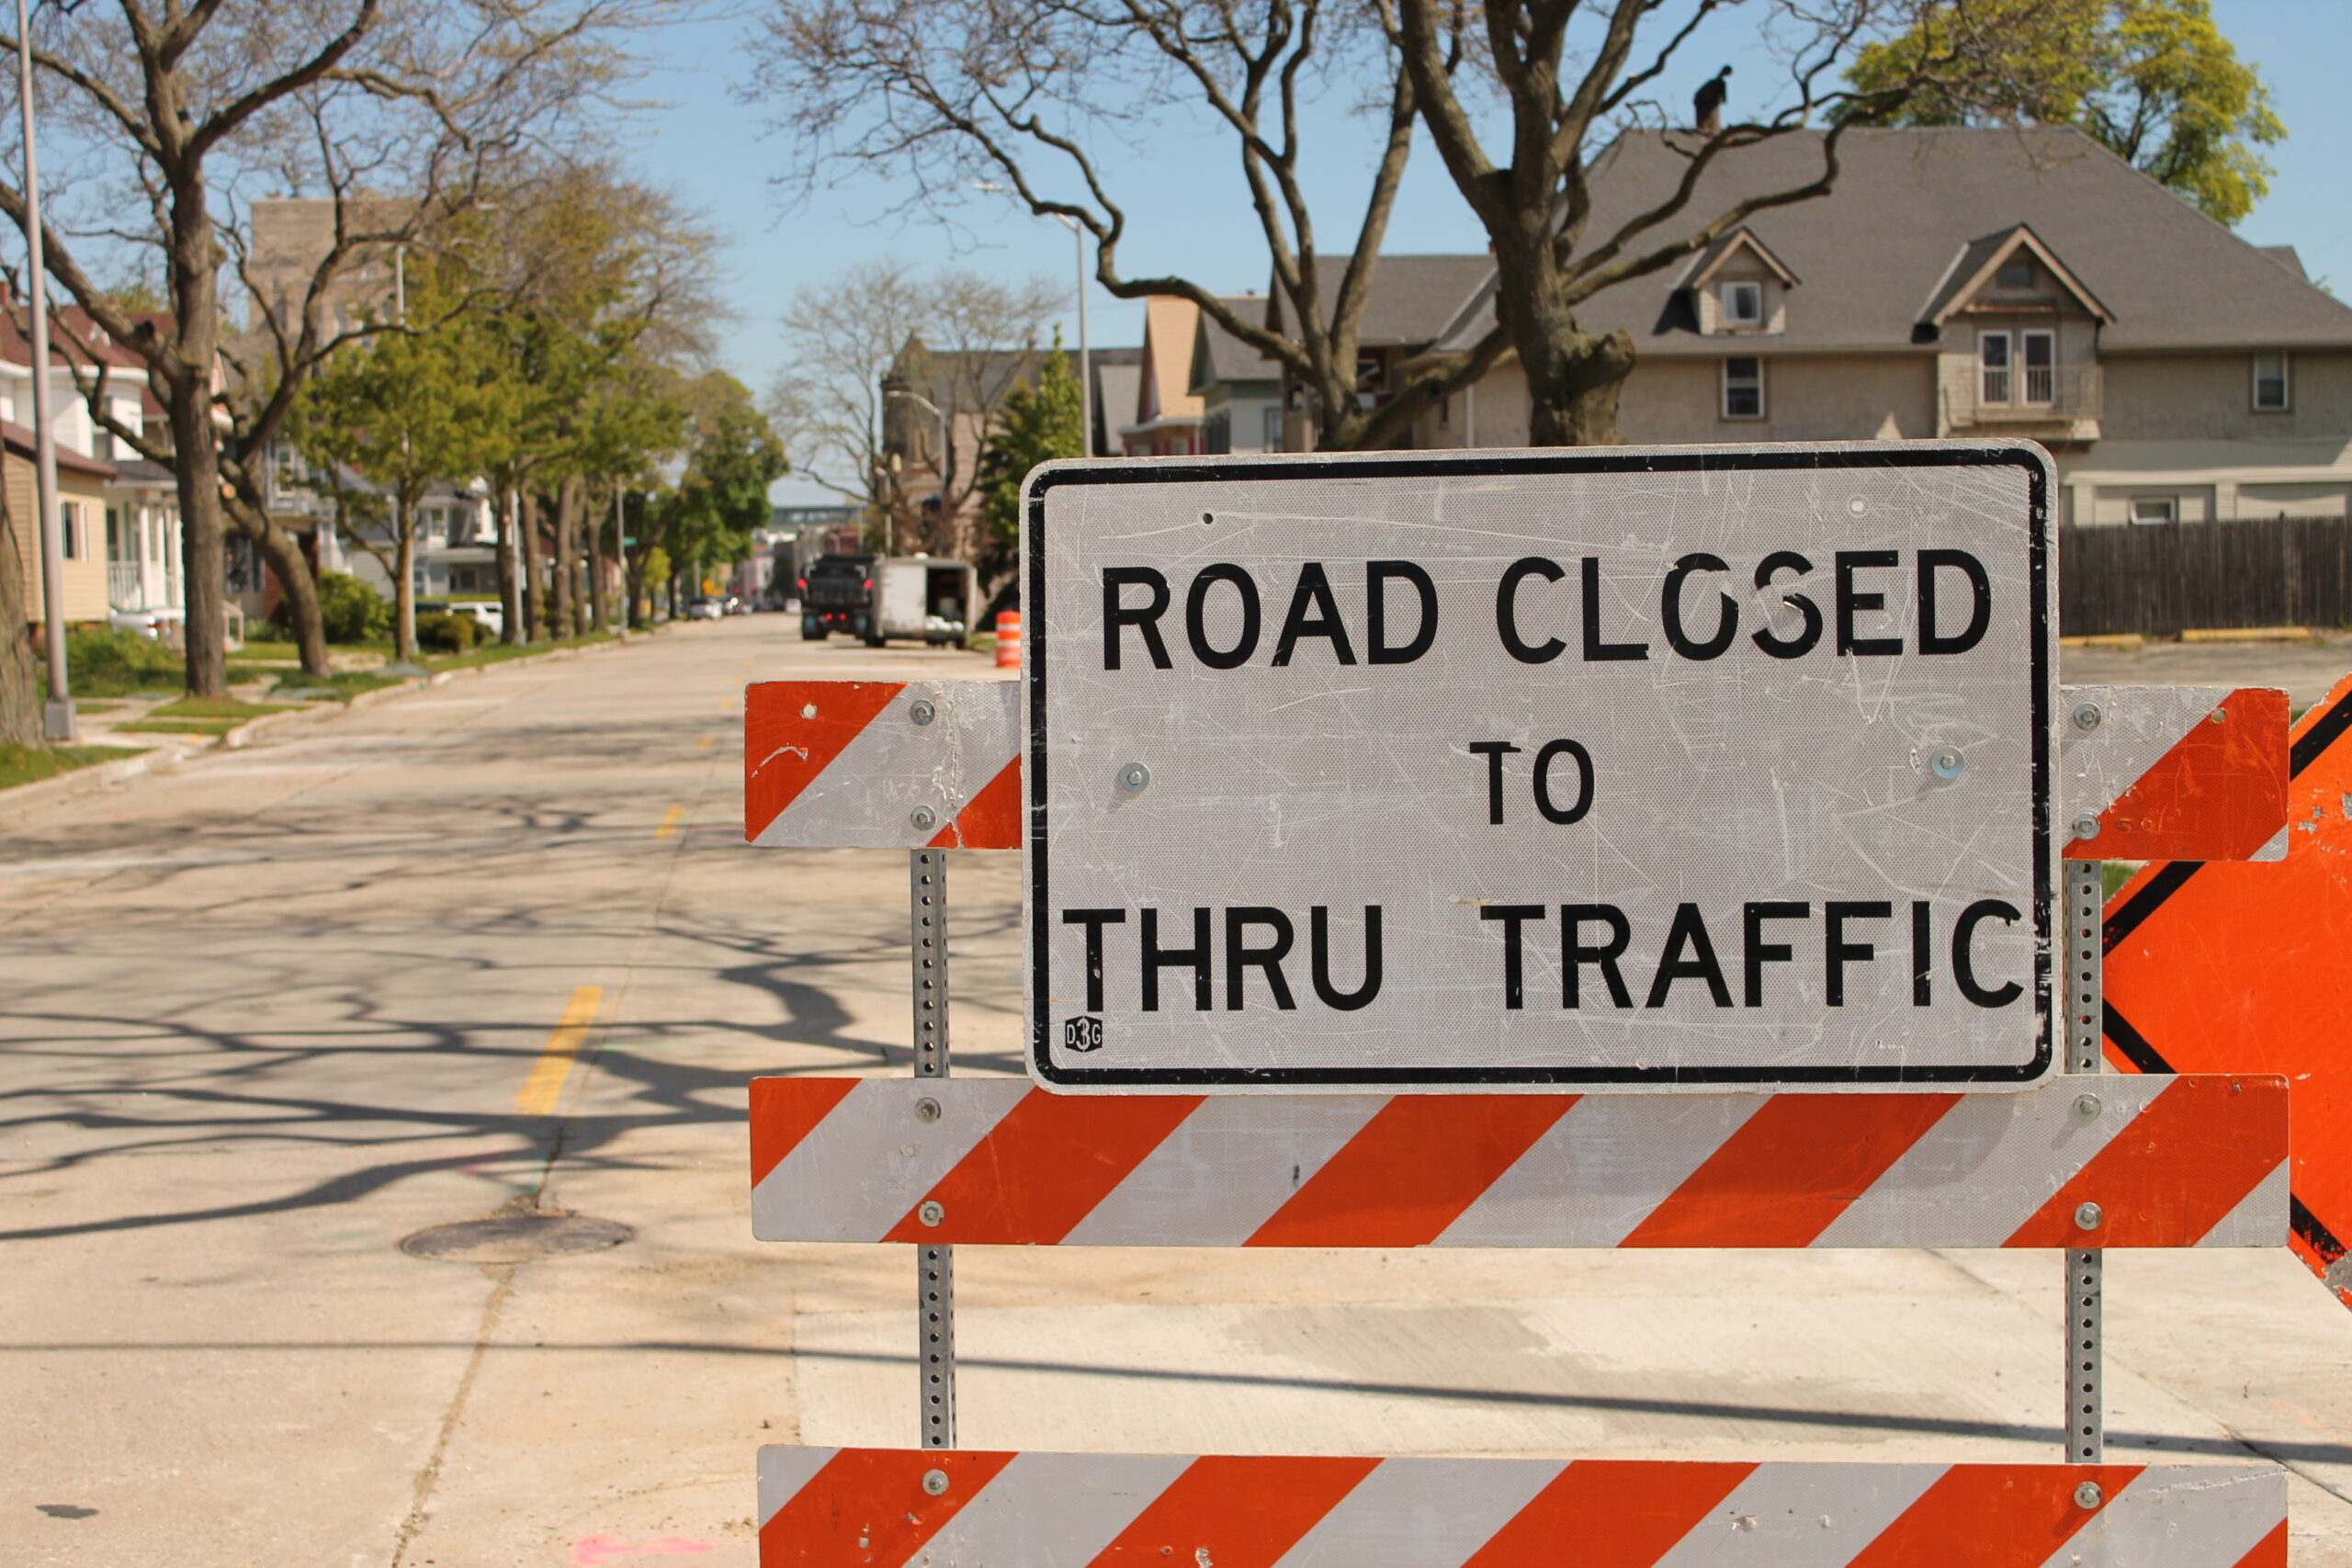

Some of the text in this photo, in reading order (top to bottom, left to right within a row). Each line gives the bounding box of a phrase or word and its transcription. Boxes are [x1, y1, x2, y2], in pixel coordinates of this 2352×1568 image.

[1103, 549, 1992, 671] ROAD CLOSED
[1470, 739, 1595, 825] TO
[1063, 898, 2024, 1012] THRU TRAFFIC
[1066, 1017, 1102, 1051] D3G
